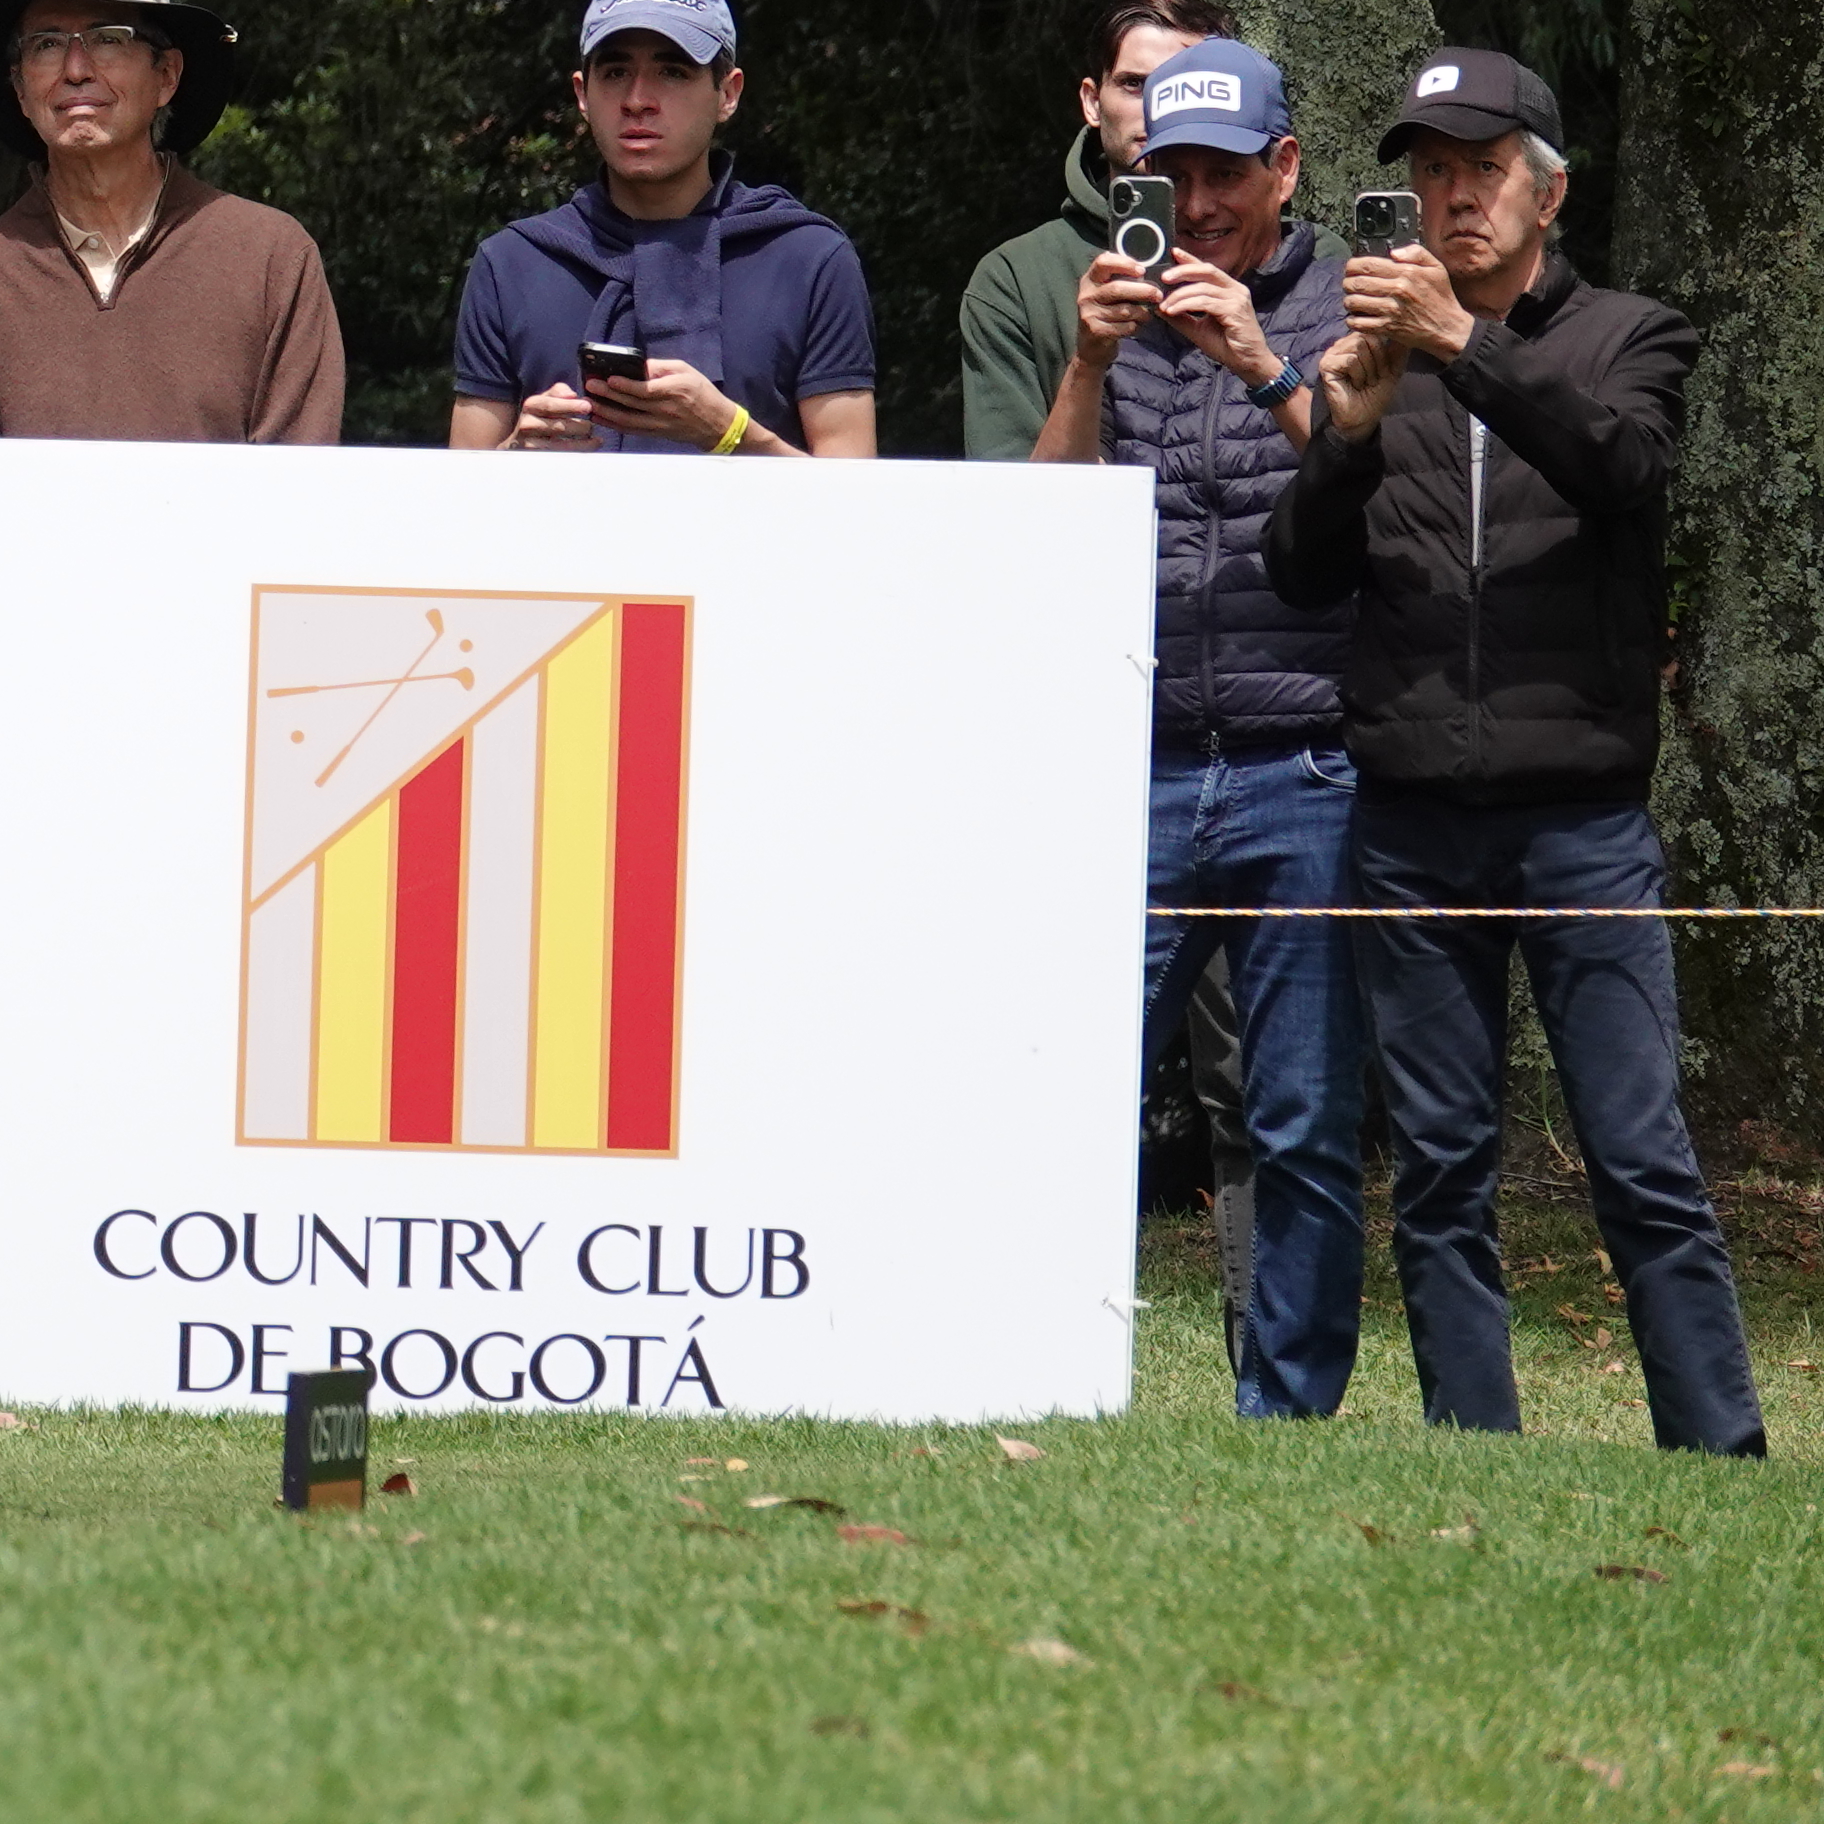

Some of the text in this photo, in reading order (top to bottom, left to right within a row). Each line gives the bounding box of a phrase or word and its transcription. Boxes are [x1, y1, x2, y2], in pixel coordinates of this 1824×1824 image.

[1156, 79, 1231, 111] PING
[92, 1209, 811, 1299] COUNTRY CLUB
[176, 1314, 727, 1410] DE BOGOTÁ
